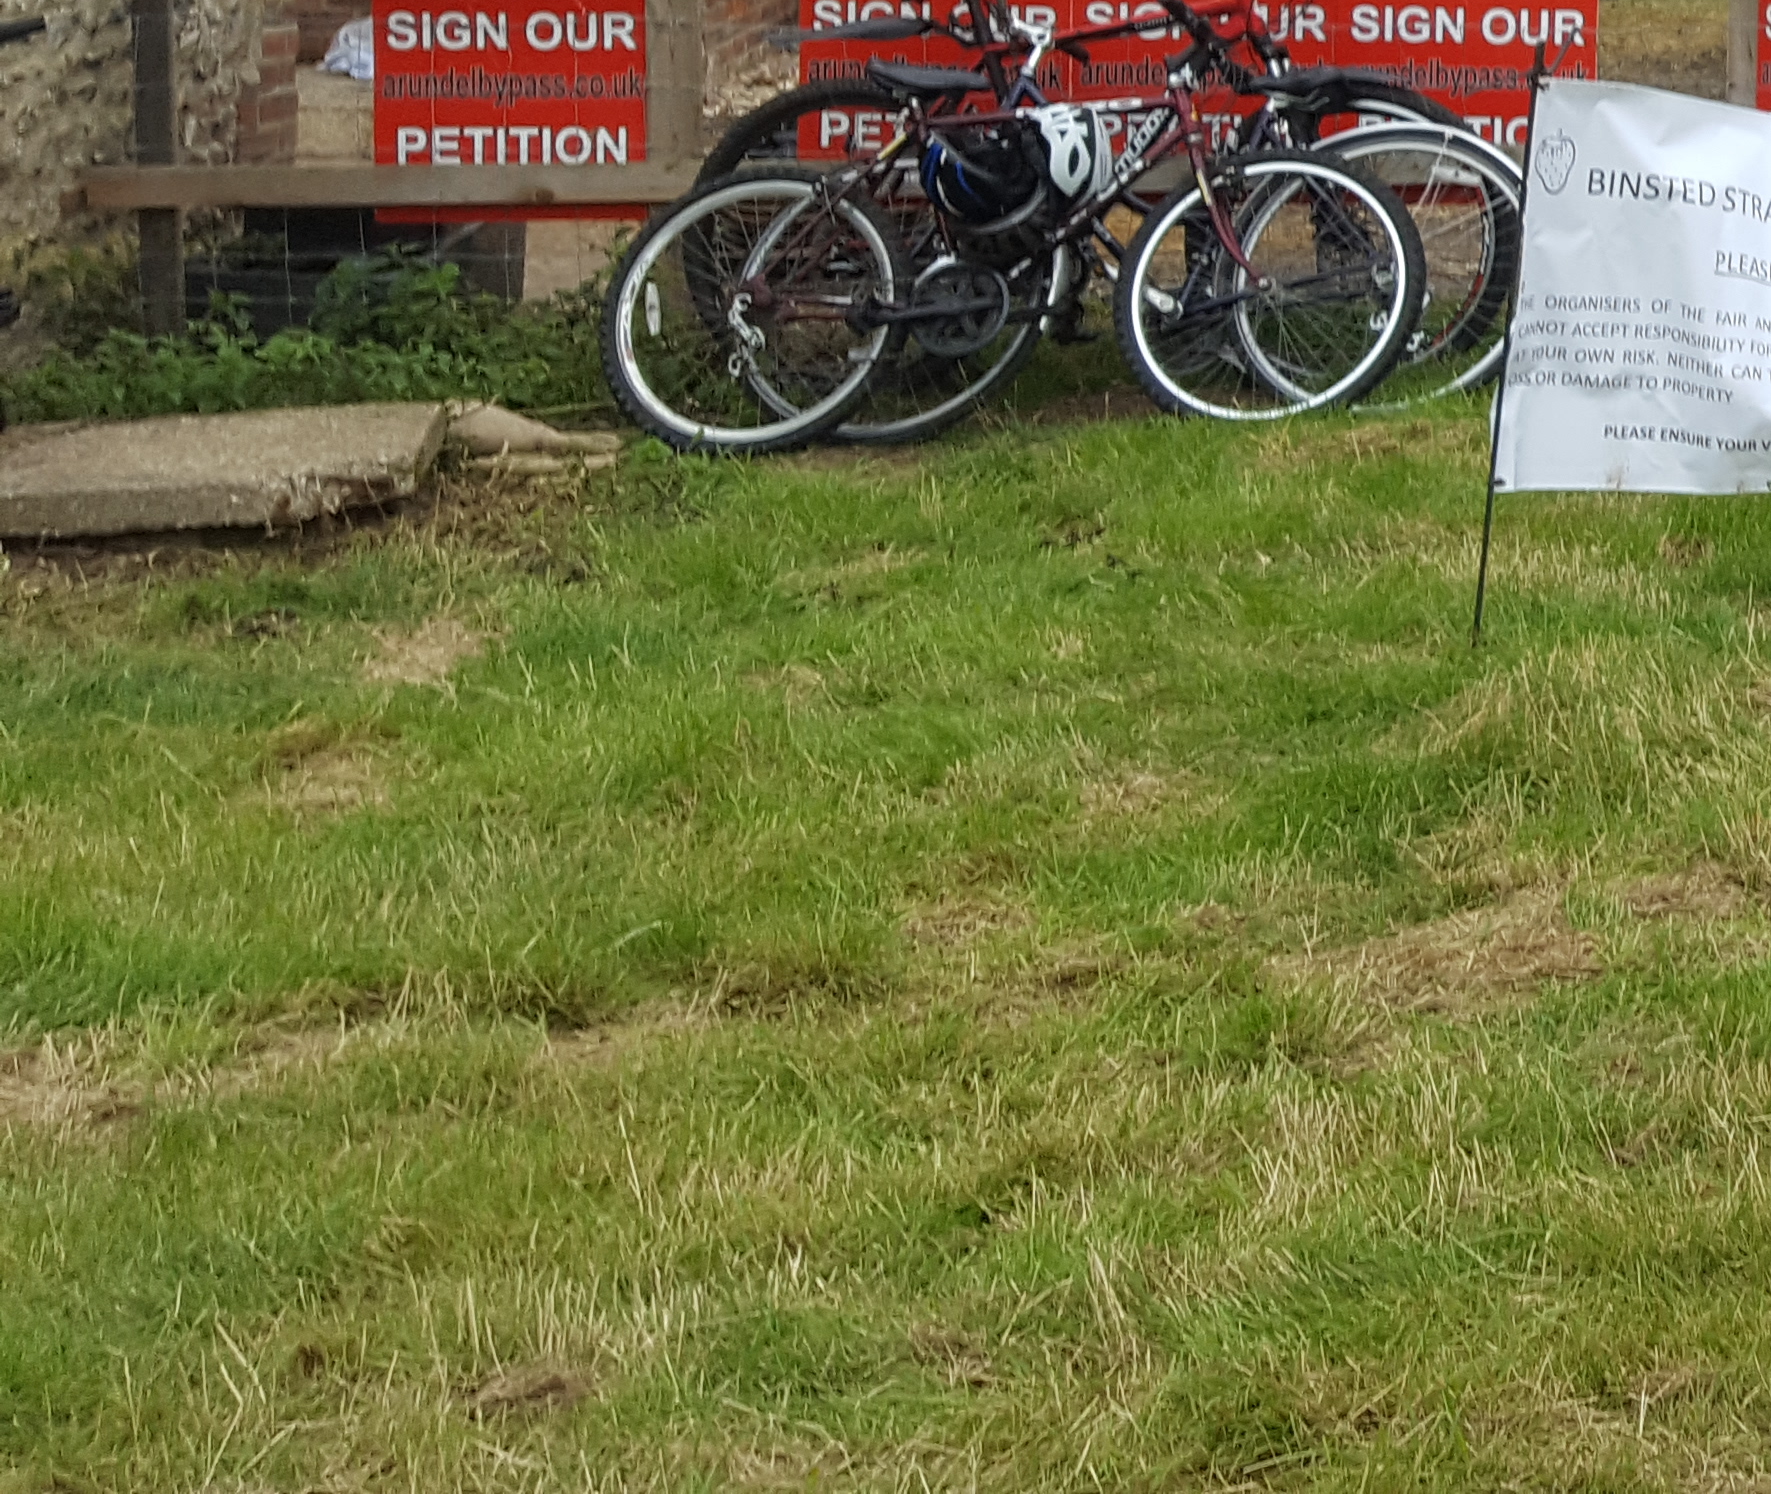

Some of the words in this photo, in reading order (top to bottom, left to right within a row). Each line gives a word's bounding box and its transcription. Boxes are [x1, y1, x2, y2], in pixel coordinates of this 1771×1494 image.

[386, 10, 508, 51] SIGN
[525, 10, 638, 52] OUR
[1350, 4, 1465, 44] SIGN
[1481, 7, 1586, 47] OUR
[383, 65, 643, 108] arundelbypass.co.uk
[396, 125, 629, 166] PETITION
[1588, 168, 1716, 206] BINSTED
[1545, 294, 1641, 314] ORGANISERS
[1651, 299, 1672, 314] OF
[1681, 303, 1705, 324] THE
[1715, 310, 1747, 327] FAIR
[1571, 321, 1628, 339] ACCEPT
[1634, 323, 1745, 353] RESPONSIBILITY
[1531, 346, 1567, 362] YOUR
[1575, 347, 1614, 364] OWN
[1668, 351, 1723, 379] NEITHER
[1731, 363, 1762, 381] CAN
[1535, 369, 1556, 387] OR
[1561, 372, 1632, 390] DAMAGE
[1638, 374, 1657, 391] TO
[1662, 376, 1733, 404] PROPERTY
[1604, 423, 1655, 442] PLEASE
[1660, 427, 1711, 450] ENSURE
[1715, 437, 1757, 452] YOUR
